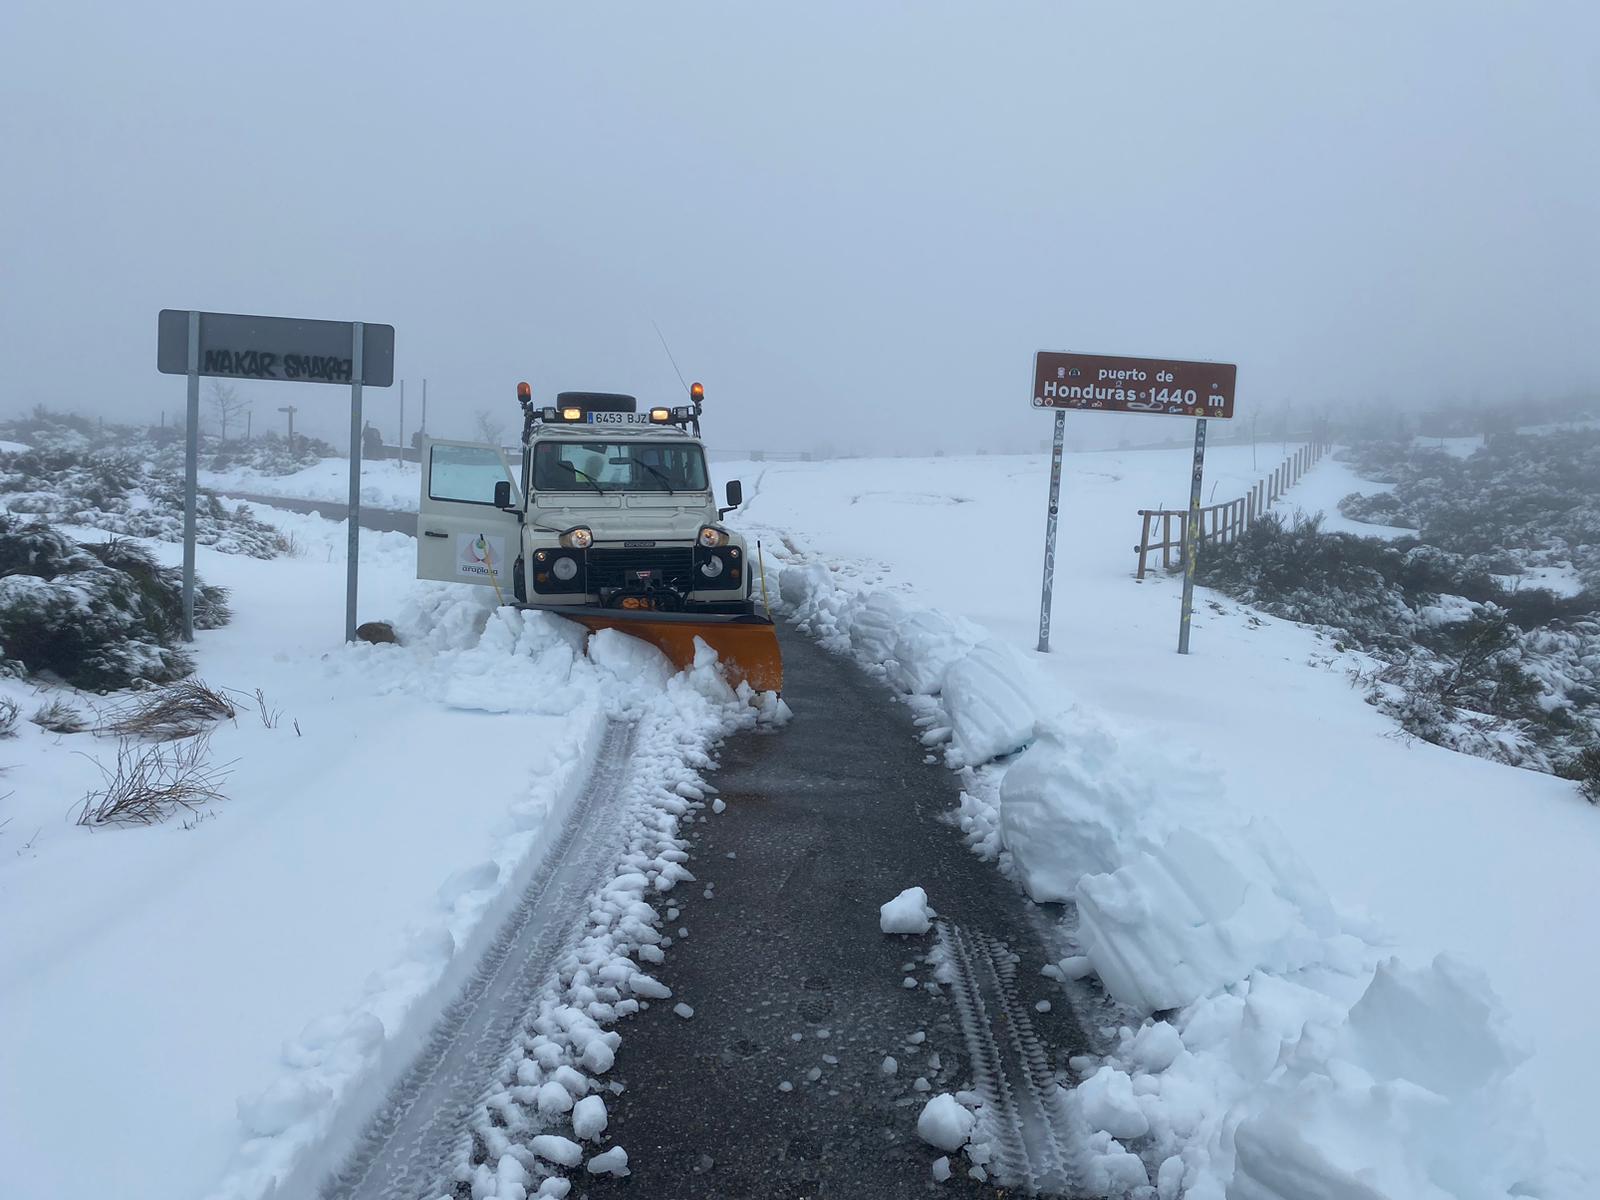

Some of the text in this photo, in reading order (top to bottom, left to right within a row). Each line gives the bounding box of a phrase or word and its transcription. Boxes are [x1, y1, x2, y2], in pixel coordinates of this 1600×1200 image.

[204, 349, 277, 377] NAKAR
[1098, 368, 1174, 383] puerto de
[1043, 381, 1225, 407] Honduras 1440 m
[595, 413, 623, 424] 6453
[627, 413, 647, 424] BJZ
